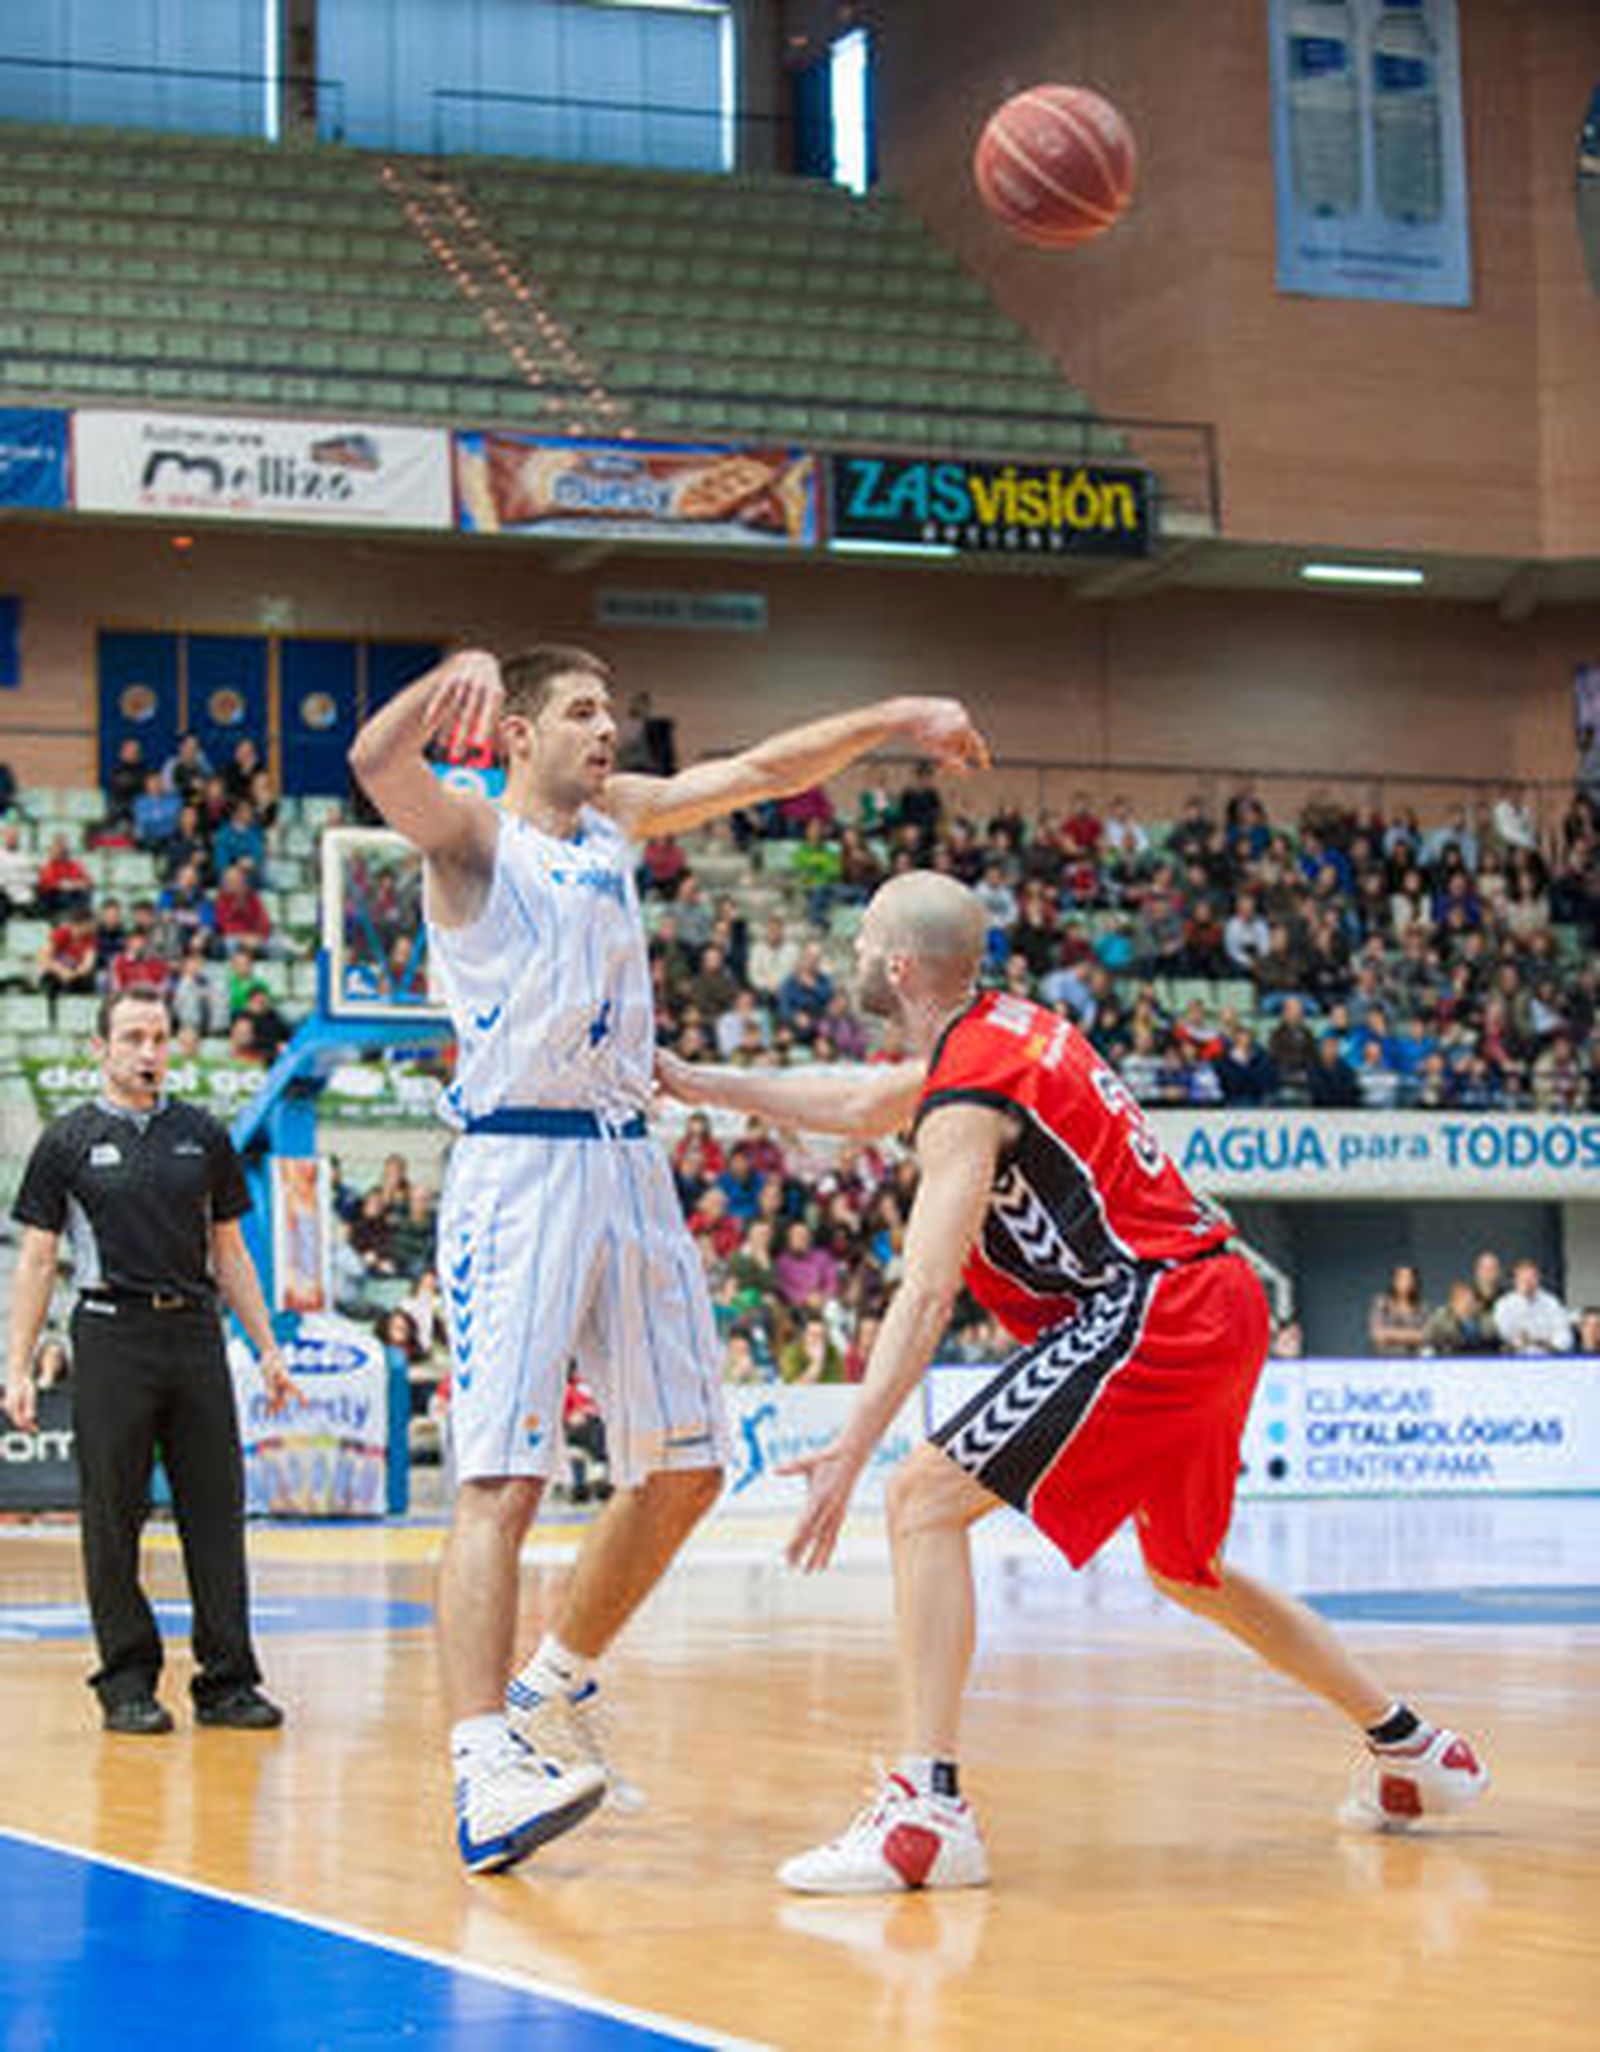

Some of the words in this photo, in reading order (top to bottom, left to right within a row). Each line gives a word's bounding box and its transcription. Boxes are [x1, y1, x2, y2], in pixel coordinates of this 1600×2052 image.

[1182, 1126, 1328, 1172] AGUA
[1338, 1133, 1431, 1168] para
[1440, 1124, 1600, 1170] TODOS
